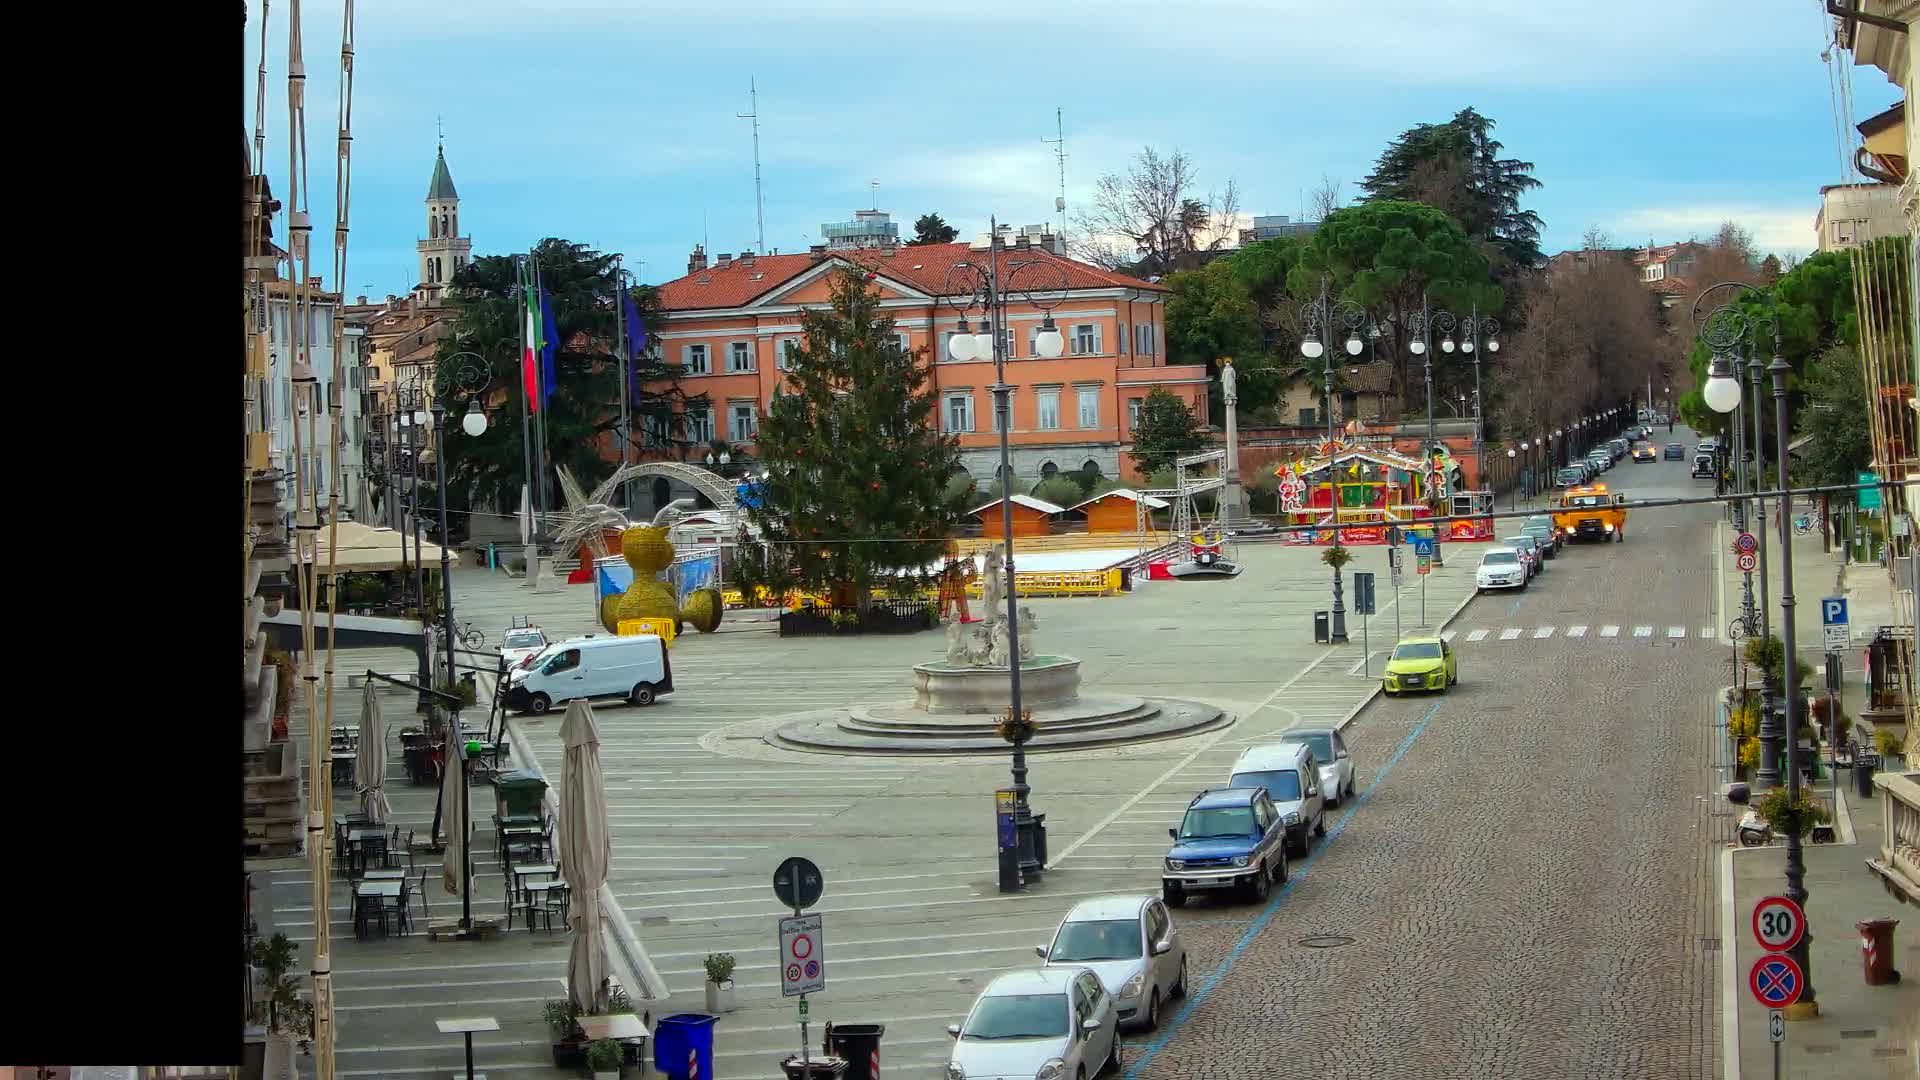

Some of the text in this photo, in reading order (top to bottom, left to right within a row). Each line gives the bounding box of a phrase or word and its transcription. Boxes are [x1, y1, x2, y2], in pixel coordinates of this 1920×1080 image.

[1742, 558, 1752, 566] 20
[1827, 602, 1842, 622] P
[1763, 912, 1791, 937] 30
